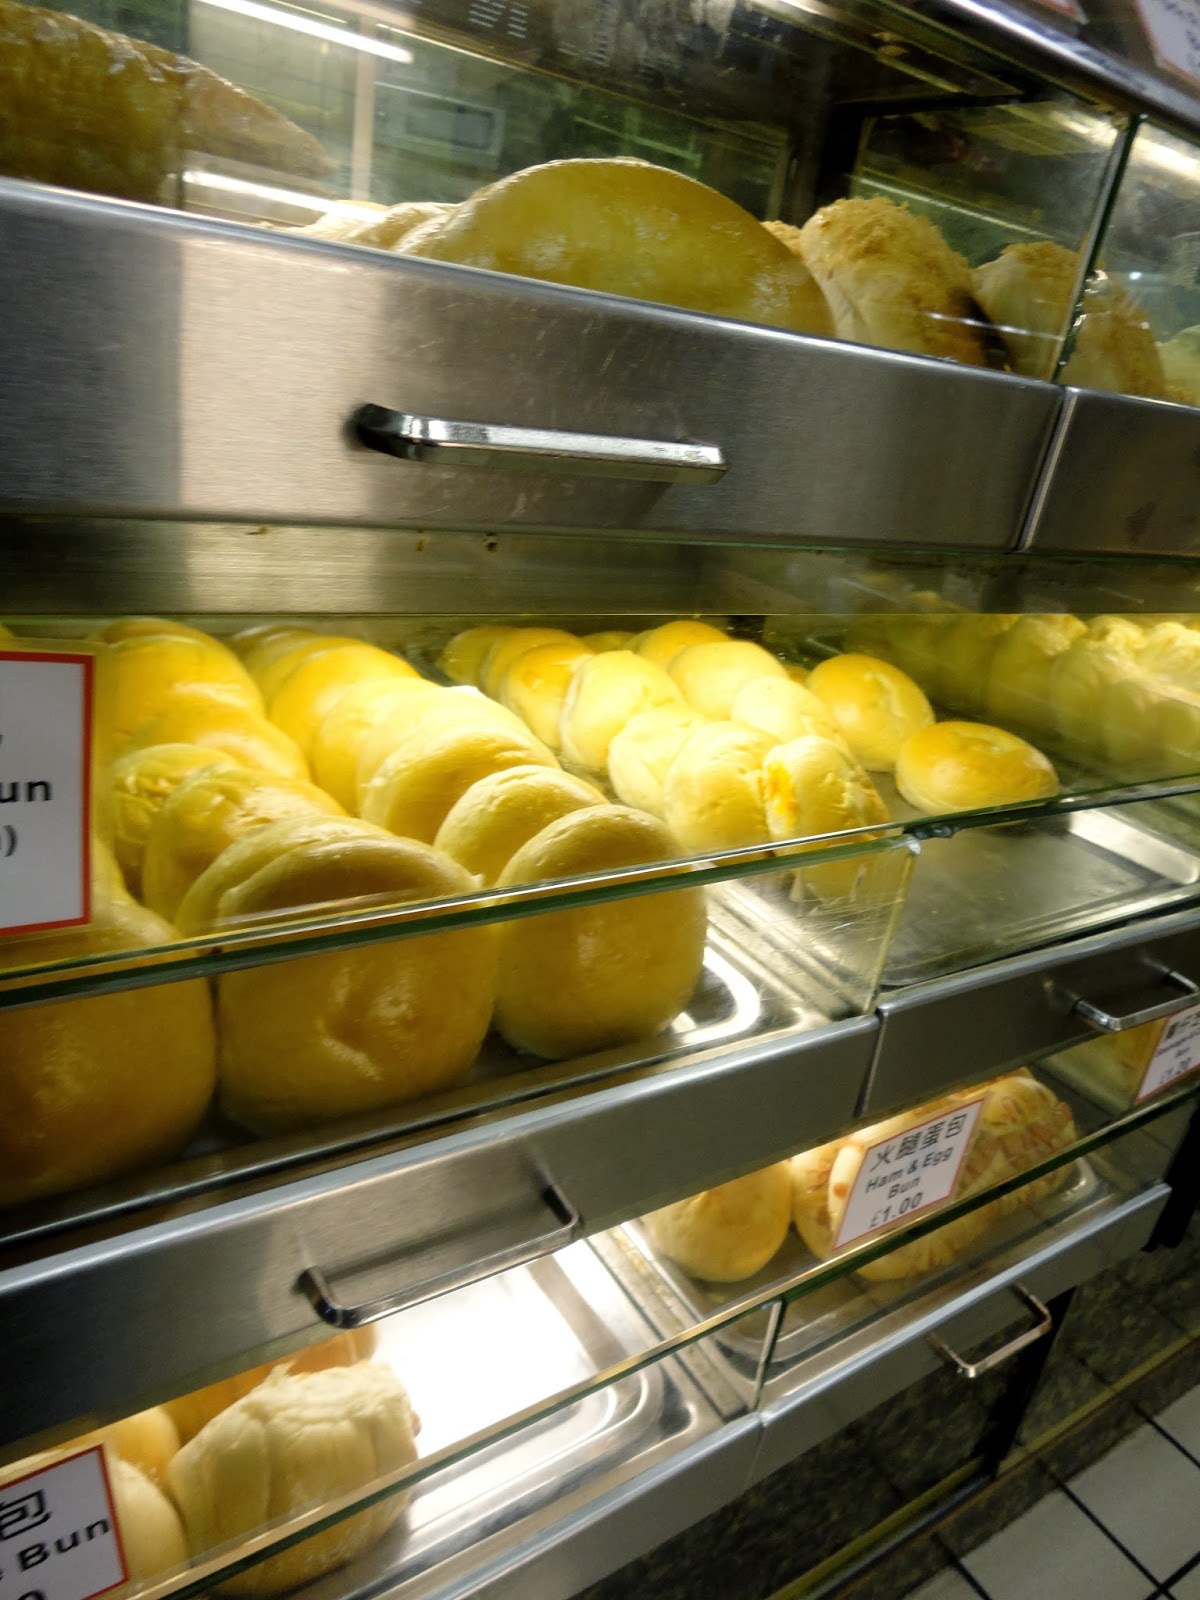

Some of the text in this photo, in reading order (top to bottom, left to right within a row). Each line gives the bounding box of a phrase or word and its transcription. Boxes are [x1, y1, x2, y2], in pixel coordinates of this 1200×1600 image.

[865, 1147, 953, 1193] Ham & Egg
[888, 1177, 920, 1198] Bun
[869, 1192, 923, 1228] £1.00
[17, 1519, 110, 1572] Bun
